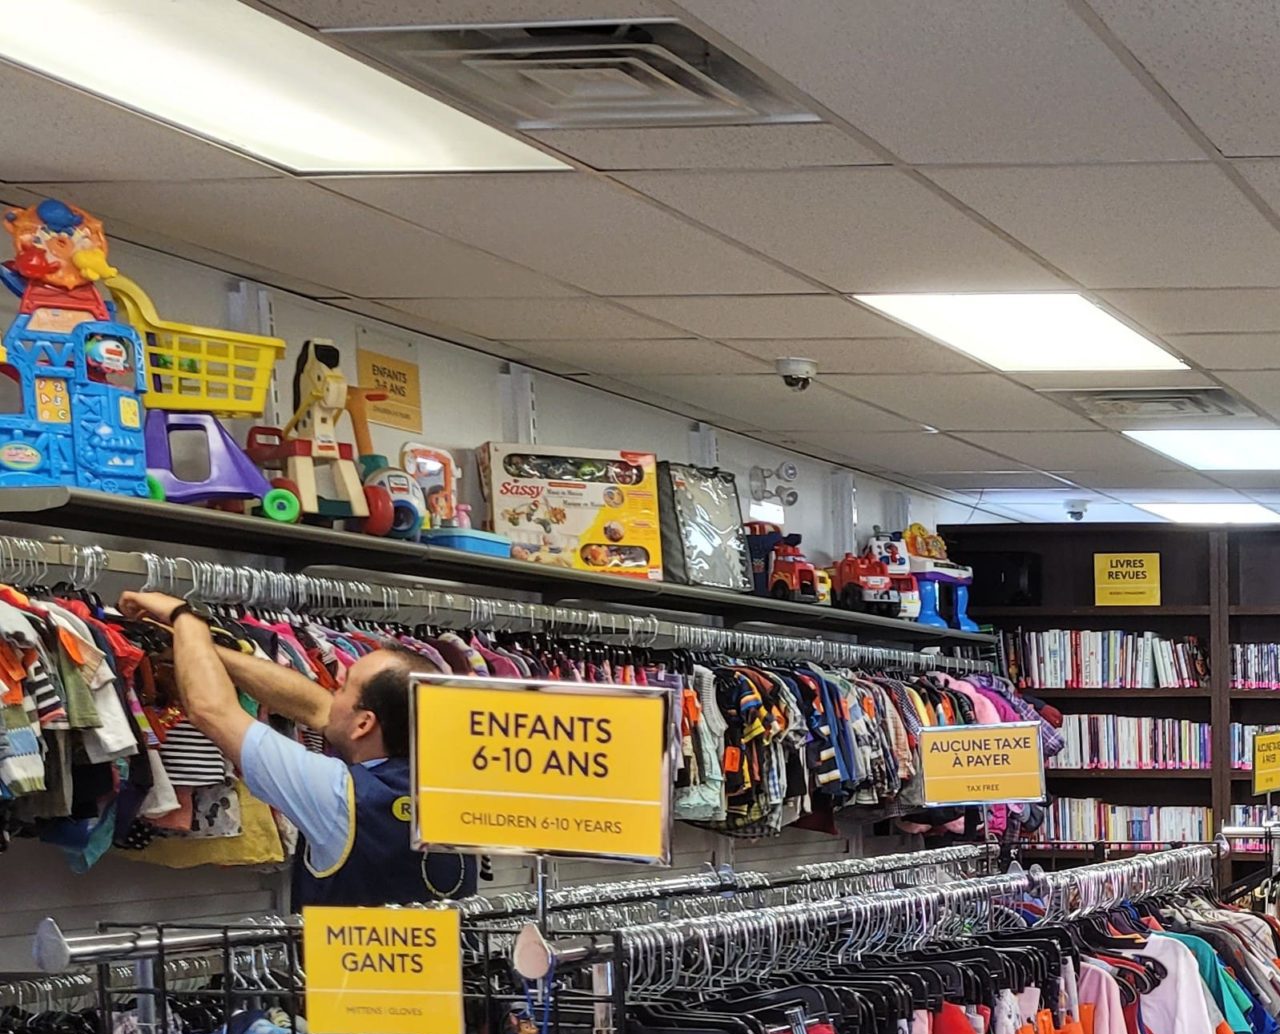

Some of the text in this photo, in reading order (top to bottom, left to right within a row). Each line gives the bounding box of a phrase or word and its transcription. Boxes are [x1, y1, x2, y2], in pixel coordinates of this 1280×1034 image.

[371, 364, 407, 384] ENFANTS
[1110, 559, 1144, 568] LIVRES
[1108, 570, 1147, 580] REVUES
[470, 710, 612, 744] ENFANTS
[930, 737, 1031, 753] AUCUNE TAXE
[472, 745, 609, 778] 6-10 ANS
[952, 753, 1011, 768] À PAYER
[460, 811, 622, 834] CHILDREN 6-10 YEARS
[326, 926, 437, 947] MITAINES
[342, 952, 423, 973] GANTS
[389, 1007, 423, 1016] GLOVES
